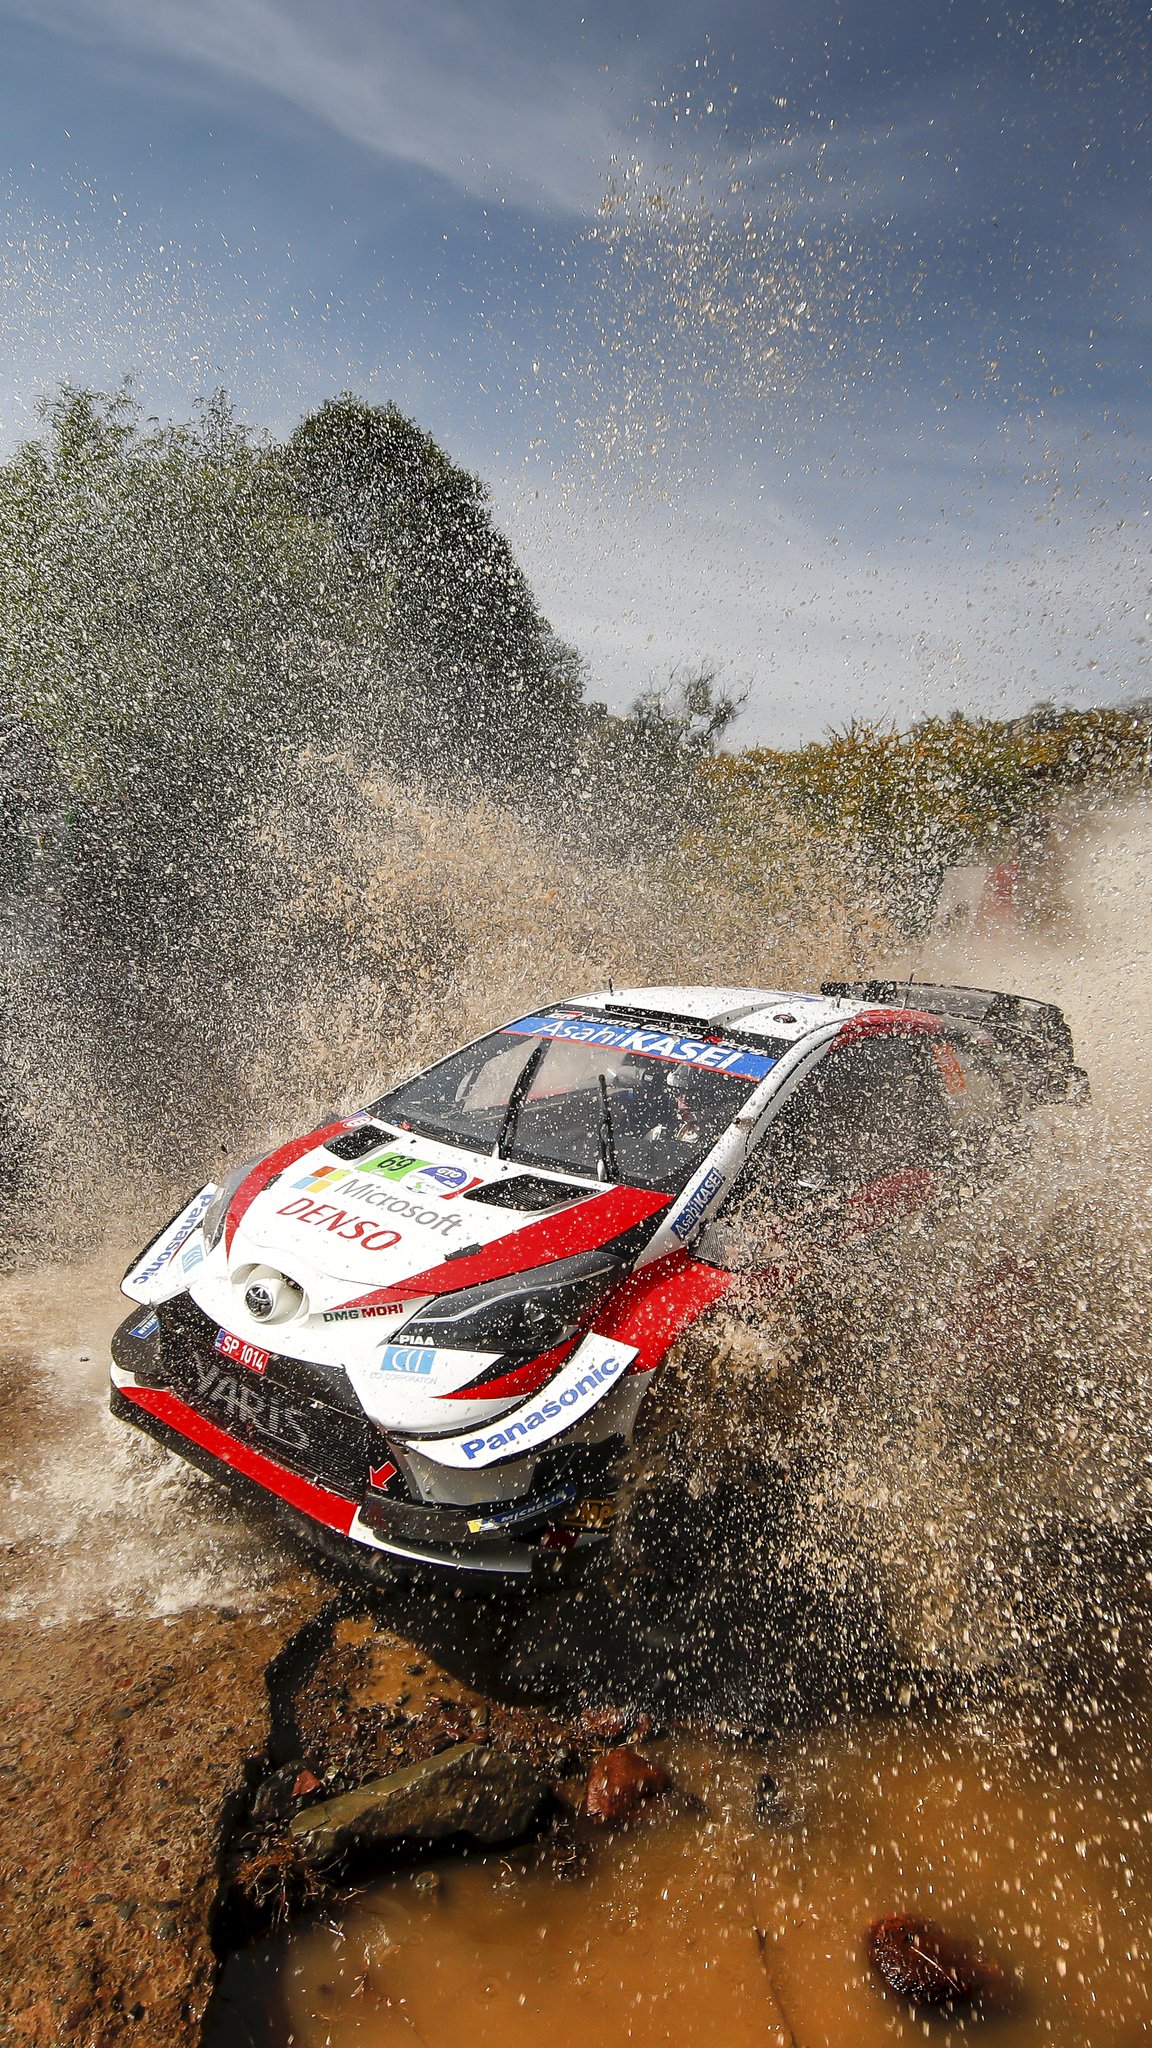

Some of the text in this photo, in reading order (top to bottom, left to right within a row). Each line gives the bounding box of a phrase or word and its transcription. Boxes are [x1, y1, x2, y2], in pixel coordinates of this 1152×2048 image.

[579, 1014, 641, 1029] TOYOTA
[376, 1155, 416, 1172] 69
[276, 1197, 402, 1251] DENSO
[334, 1178, 463, 1236] Microsoft
[132, 1193, 215, 1285] Panasonic
[322, 1303, 404, 1323] DMG MORI
[221, 1335, 265, 1371] SP 1014
[399, 1334, 435, 1346] PIAA
[384, 1373, 438, 1385] CORPORATION
[193, 1351, 311, 1450] YARIS
[460, 1355, 620, 1460] Panasonic
[500, 1490, 568, 1524] MICHELIN
